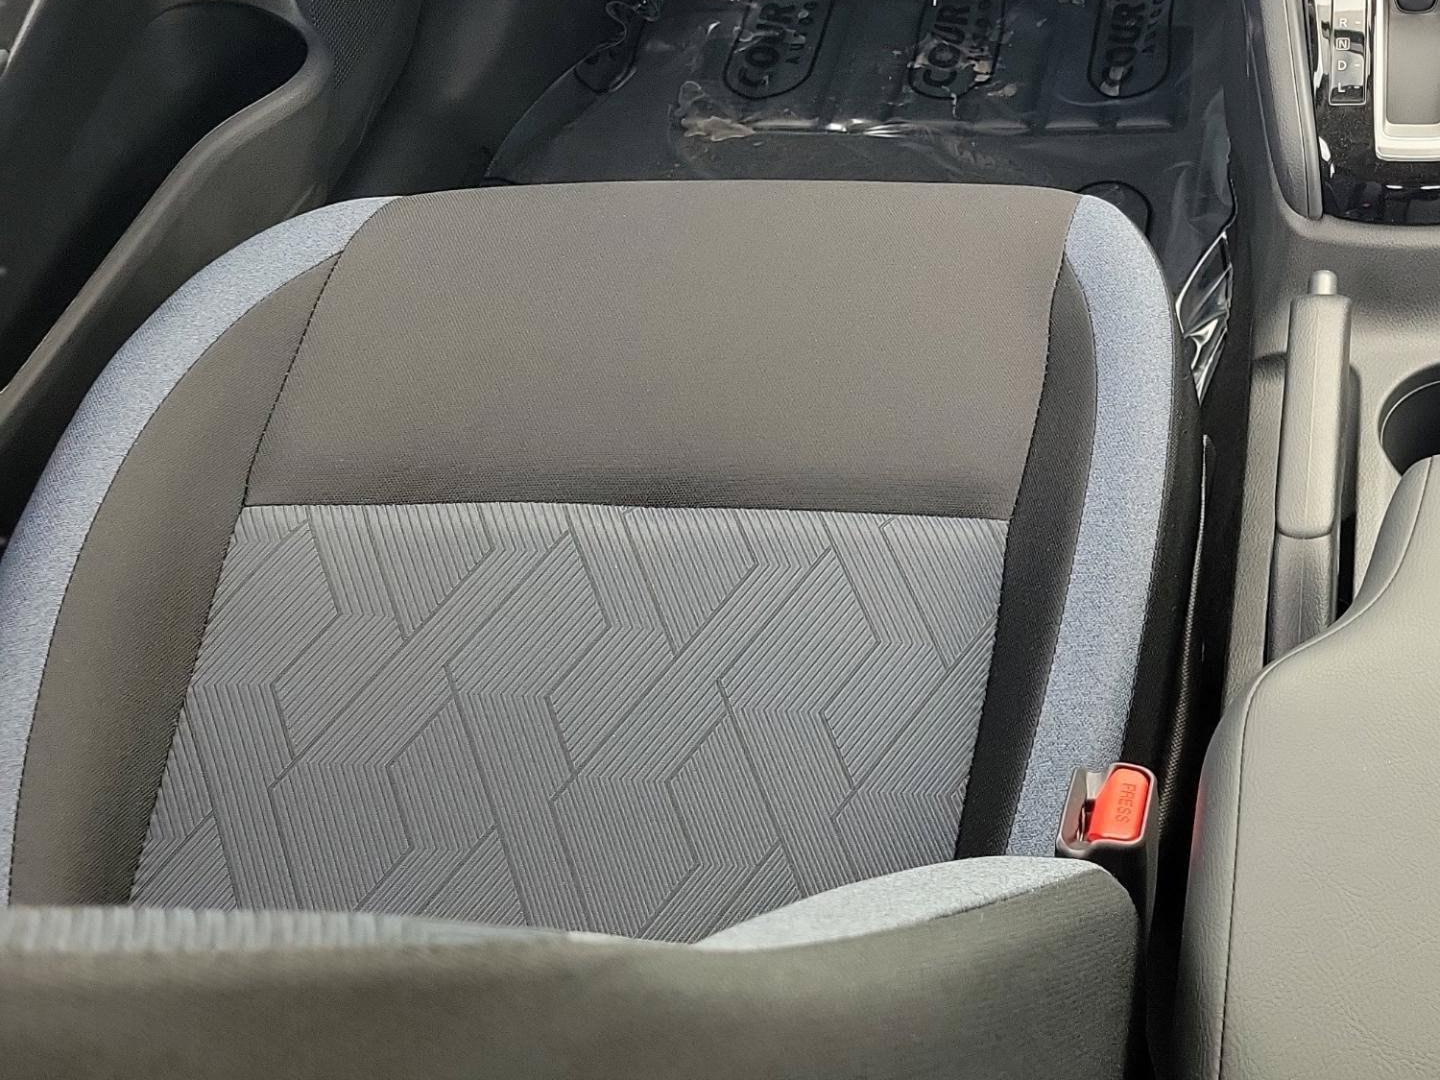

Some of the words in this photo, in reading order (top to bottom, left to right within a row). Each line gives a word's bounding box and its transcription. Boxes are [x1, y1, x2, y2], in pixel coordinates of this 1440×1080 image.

[1339, 18, 1348, 27] R
[1339, 39, 1347, 48] N
[1337, 60, 1347, 71] D
[1337, 82, 1346, 93] L
[1114, 783, 1137, 824] PRESS
